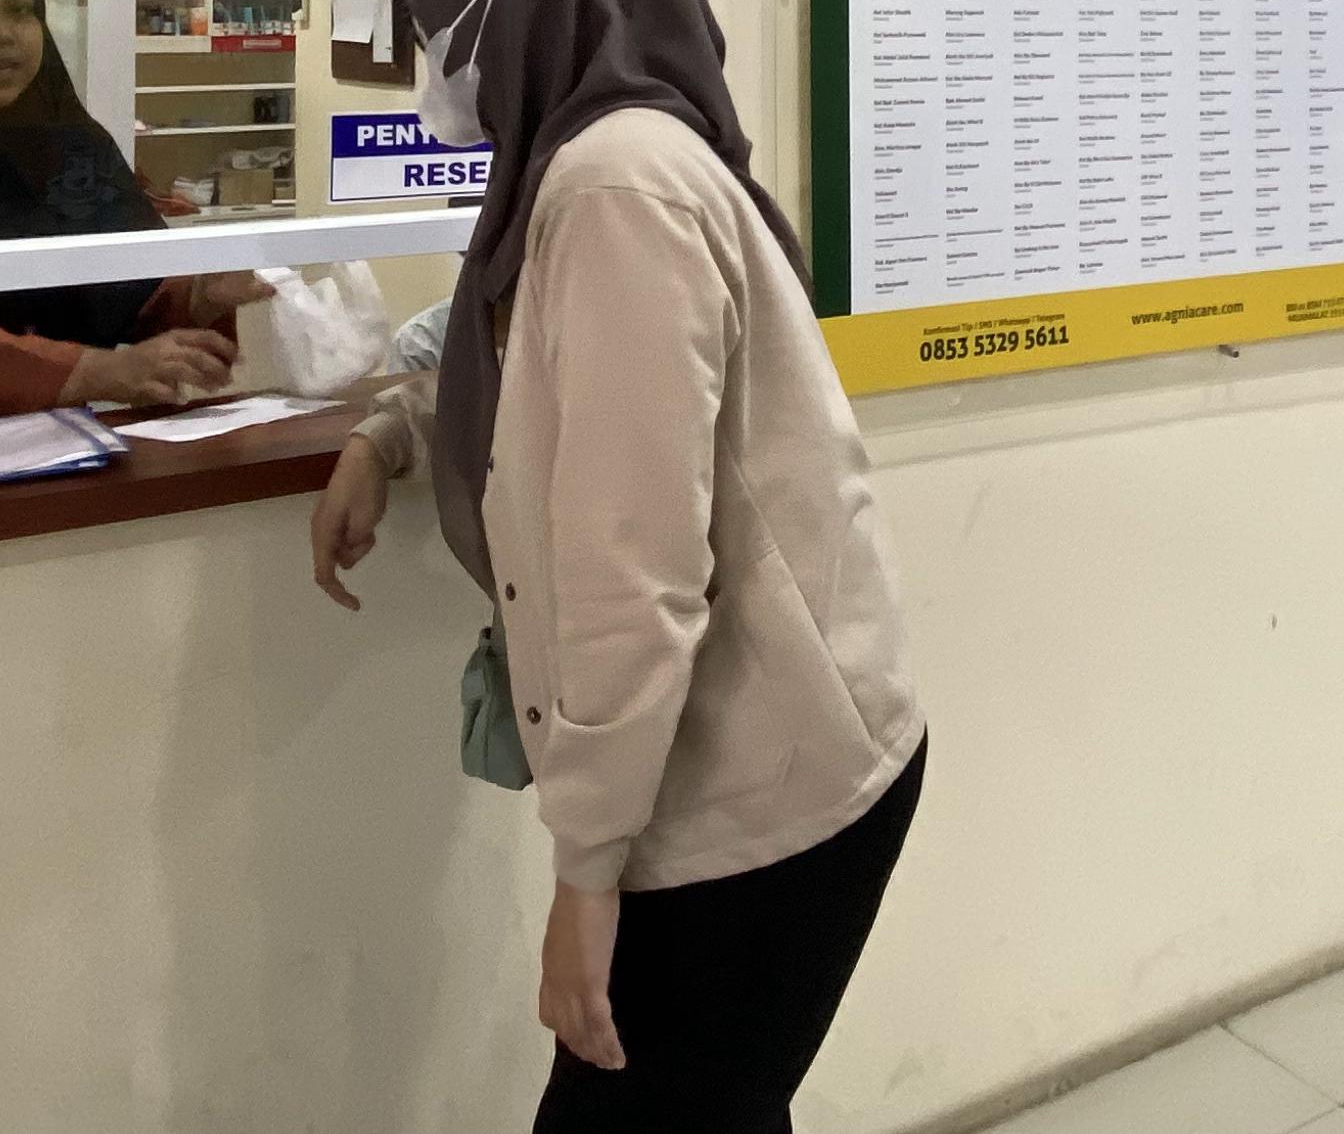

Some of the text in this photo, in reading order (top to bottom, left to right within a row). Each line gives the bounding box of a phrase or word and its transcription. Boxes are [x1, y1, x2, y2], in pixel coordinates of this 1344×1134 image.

[356, 123, 441, 147] PENY
[403, 161, 488, 188] RESE
[1131, 302, 1245, 326] www.agniacare.com
[919, 324, 1070, 362] 0853 5329 5611
